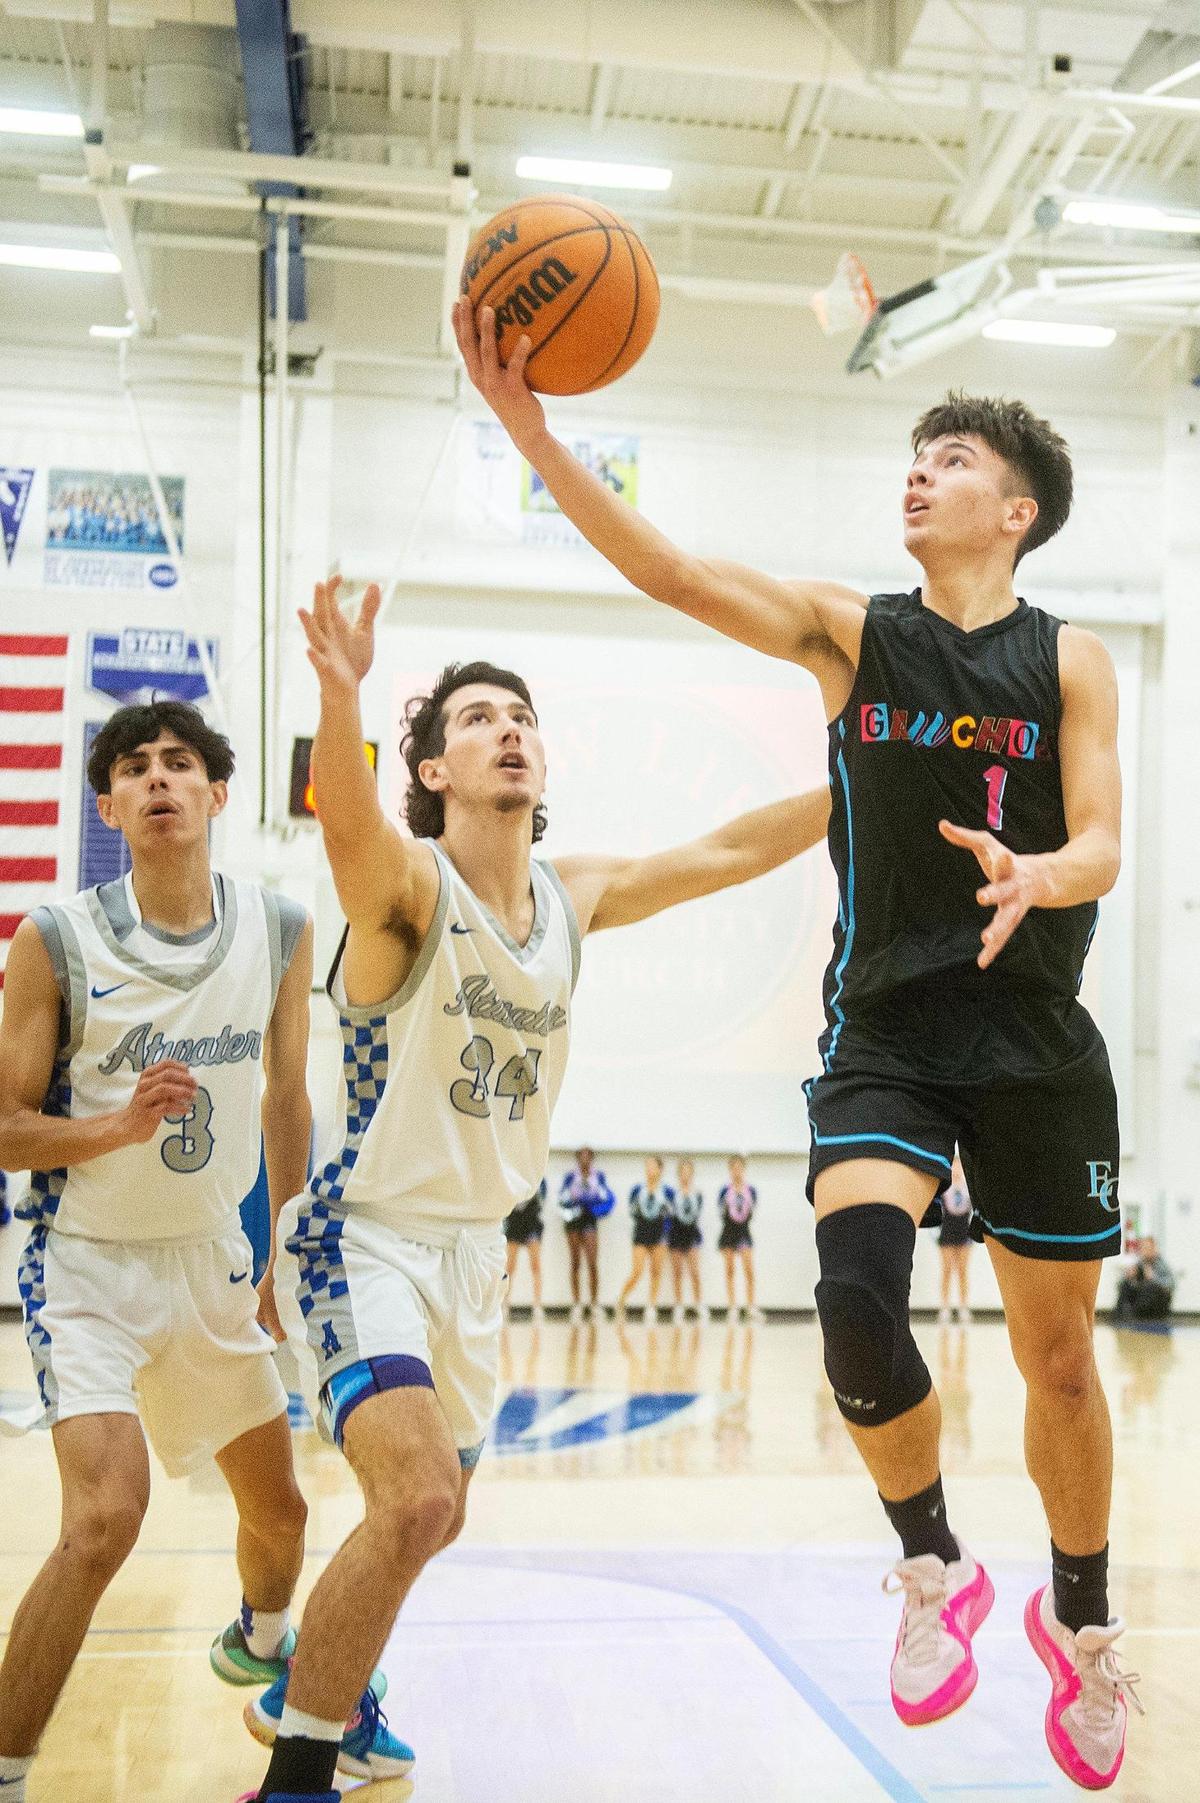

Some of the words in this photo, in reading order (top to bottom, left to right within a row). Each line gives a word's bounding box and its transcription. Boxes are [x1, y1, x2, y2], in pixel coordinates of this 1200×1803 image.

[494, 257, 578, 339] Wils
[983, 765, 1008, 831] 1
[450, 1034, 542, 1121] 34
[161, 1086, 215, 1173] 3
